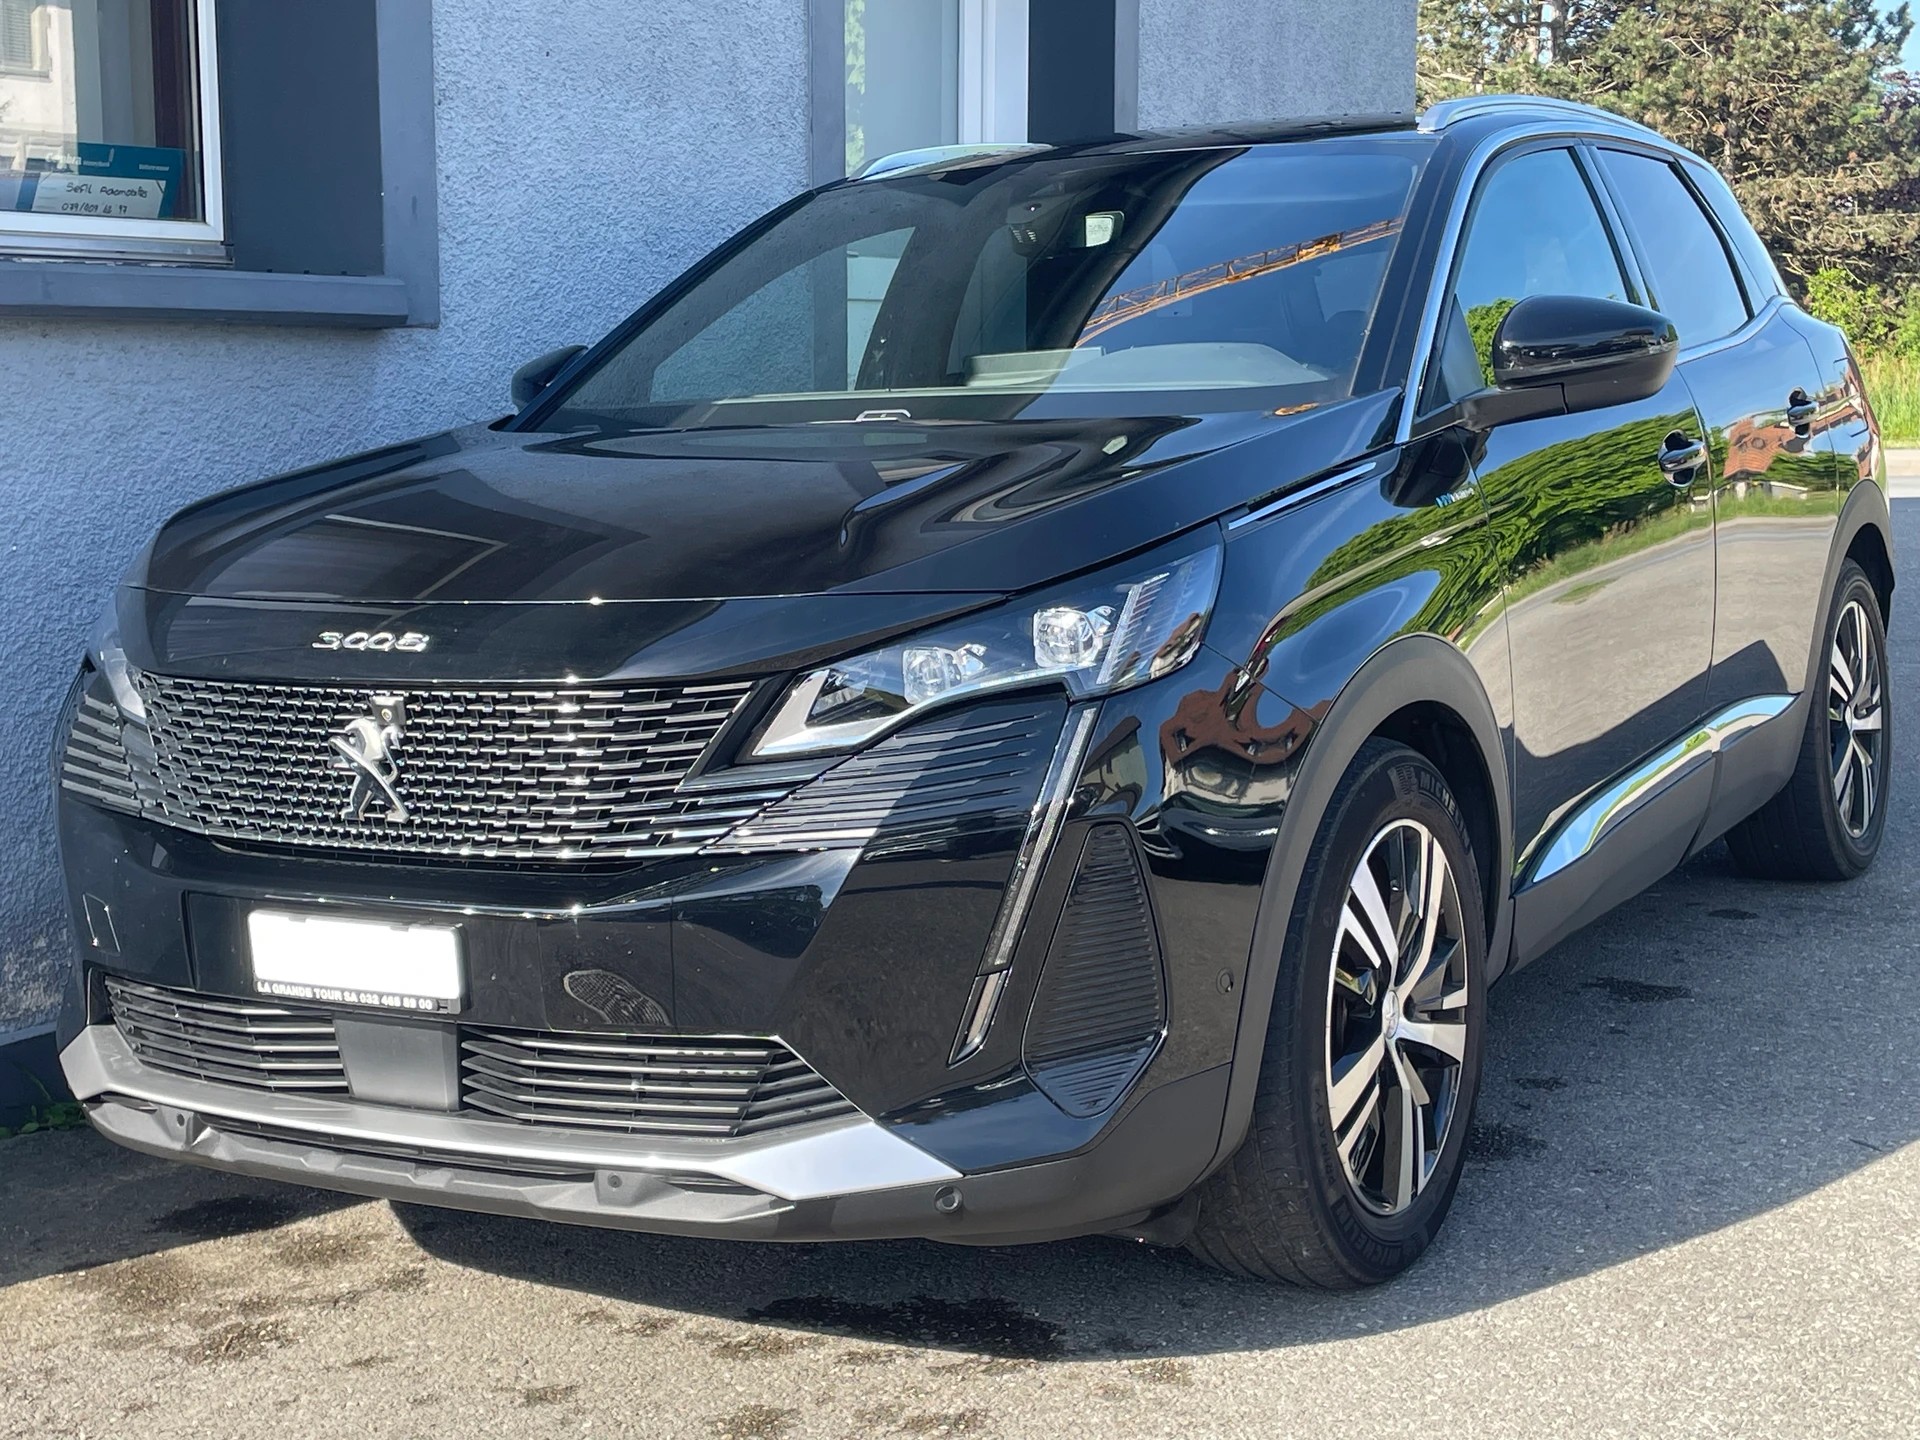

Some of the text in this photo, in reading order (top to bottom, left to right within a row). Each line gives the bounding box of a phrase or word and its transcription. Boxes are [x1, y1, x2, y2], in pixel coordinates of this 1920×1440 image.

[312, 631, 430, 651] 3008
[257, 981, 271, 993] LA
[272, 983, 313, 998] GRANDE
[313, 988, 342, 1001] TOUR
[343, 991, 358, 1003] SA
[418, 998, 433, 1010] 00
